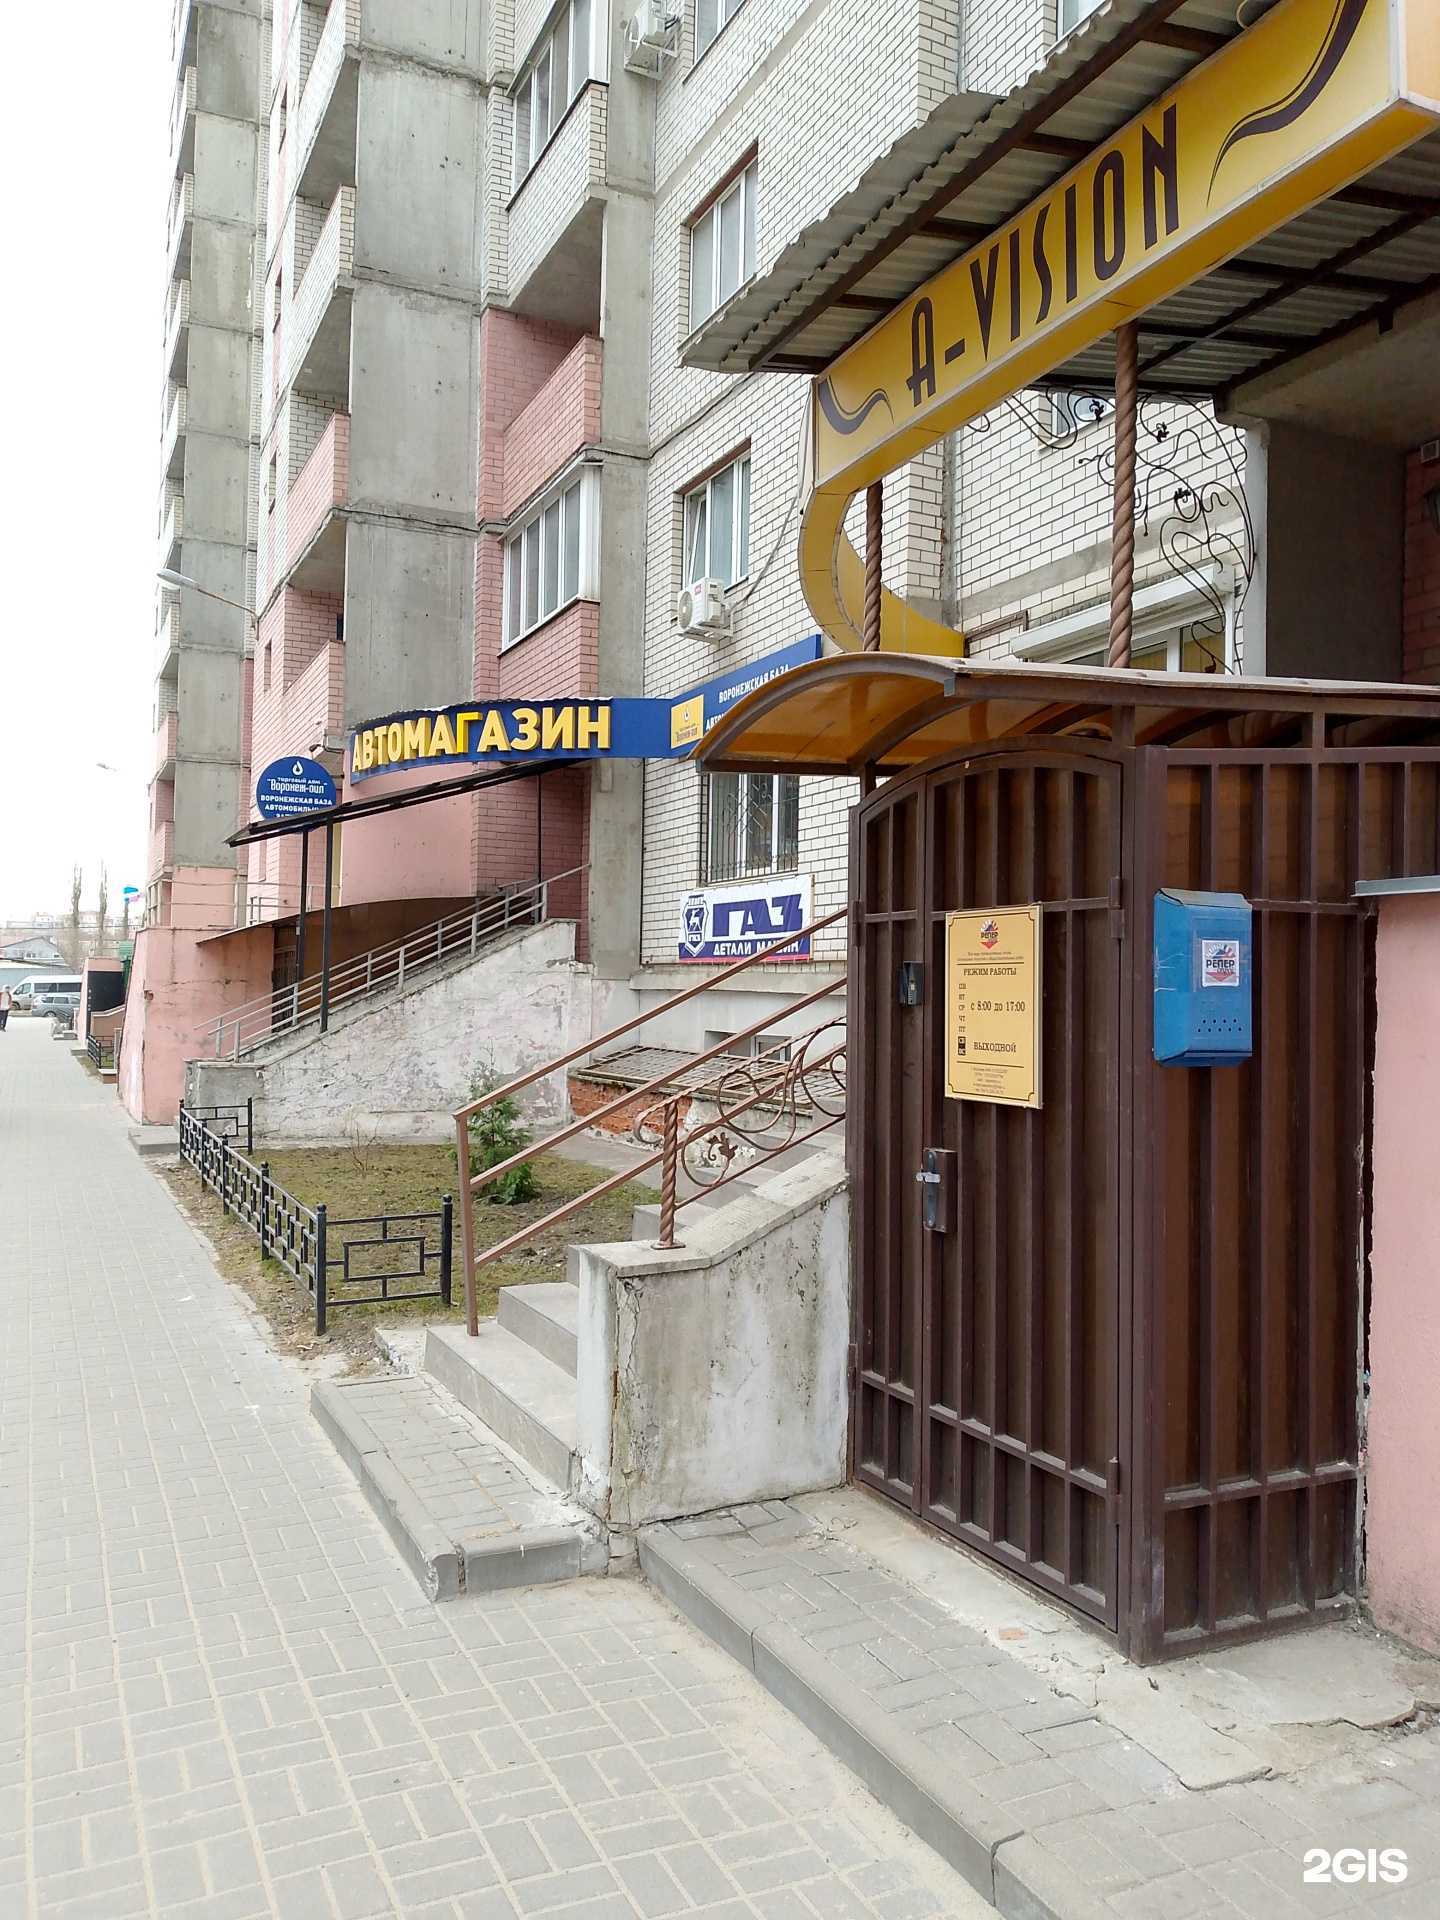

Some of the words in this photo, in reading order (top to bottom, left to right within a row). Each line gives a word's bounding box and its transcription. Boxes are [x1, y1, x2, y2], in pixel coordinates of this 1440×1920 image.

[906, 103, 1180, 408] A-VISION
[718, 671, 769, 704] ВОРОНЕЖСКАЯ
[351, 705, 611, 773] АВТОМАГАЗИН
[260, 795, 313, 804] ВОРОНЕЖСКАЯ
[712, 893, 803, 937] ГАЗ
[713, 941, 752, 956] ДЕТАЛИ
[1206, 959, 1235, 969] РЕПЕР
[963, 968, 989, 976] РЕЖИМ
[989, 967, 1017, 976] РАБОТЫ
[977, 1000, 992, 1011] 8:00
[994, 1002, 1004, 1012] до
[1006, 1001, 1026, 1012] 17:00
[973, 1041, 1017, 1054] ВЫХОДНОЙ
